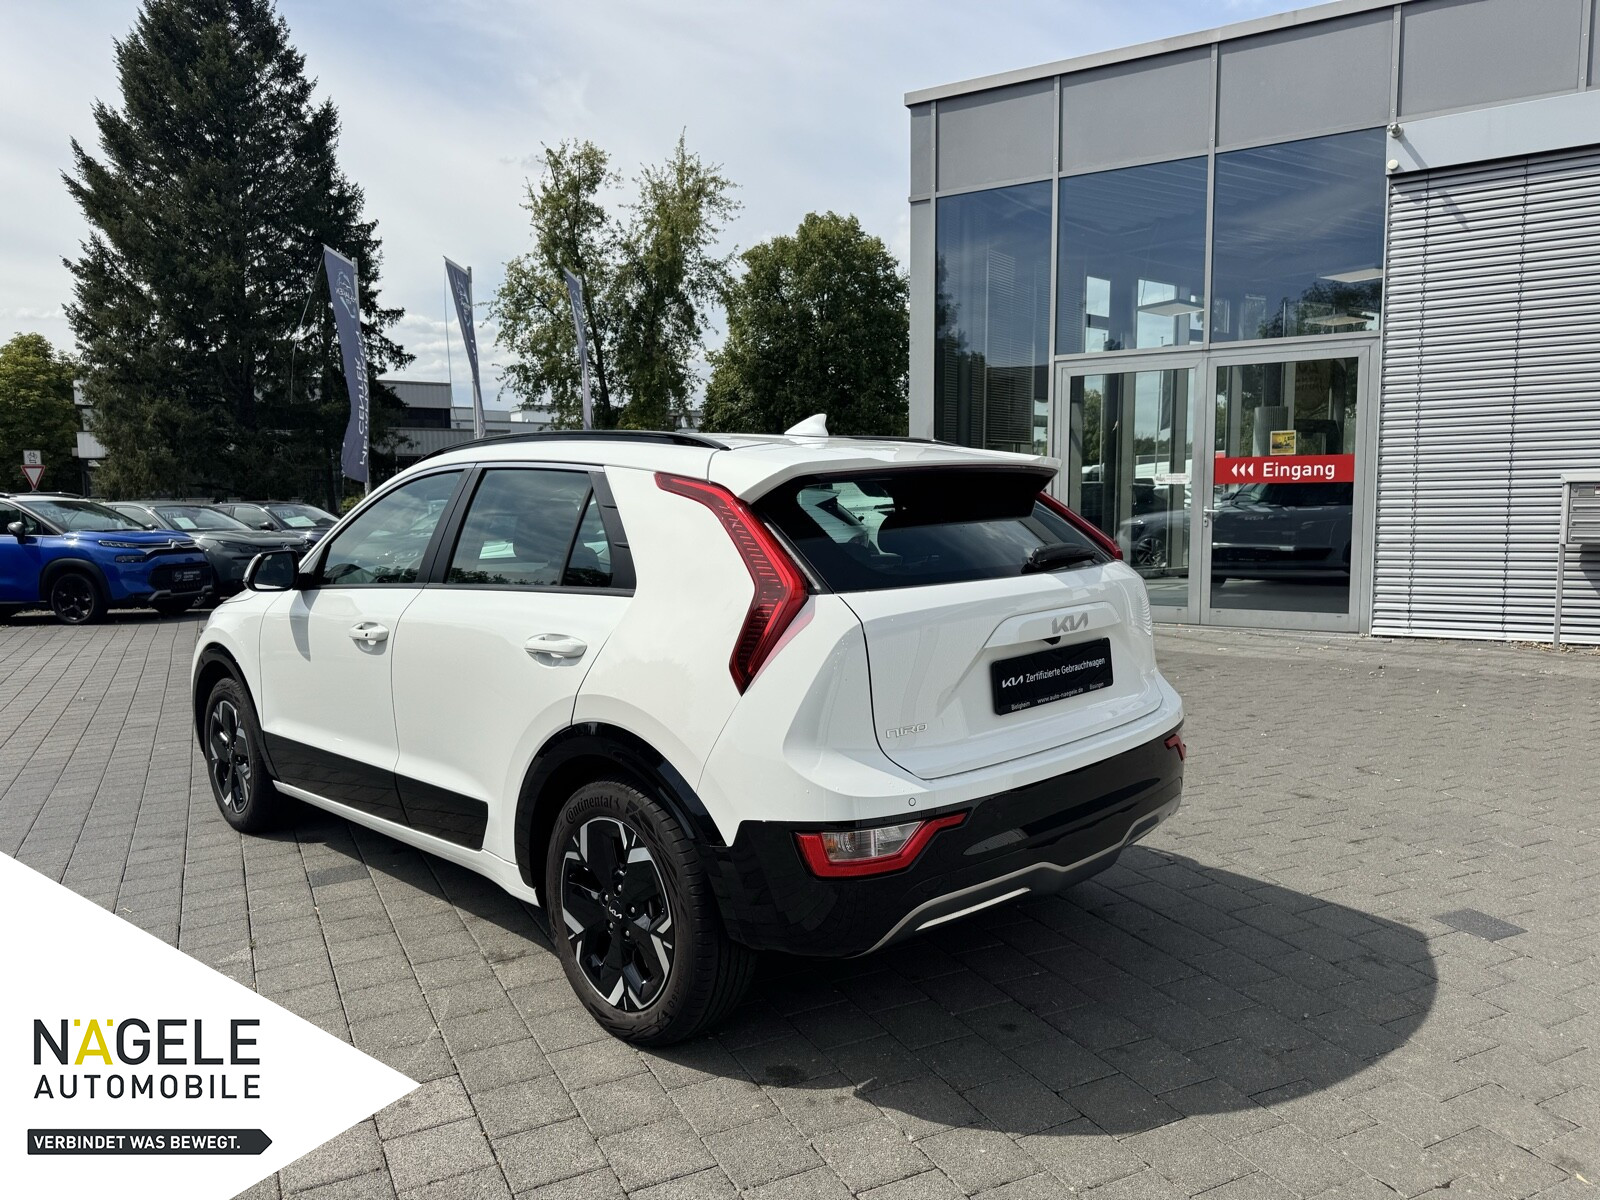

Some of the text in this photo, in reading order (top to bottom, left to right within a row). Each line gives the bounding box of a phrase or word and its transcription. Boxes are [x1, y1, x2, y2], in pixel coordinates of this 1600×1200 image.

[1263, 462, 1335, 480] Eingang
[1026, 667, 1061, 683] Zertifizierte
[1061, 657, 1106, 675] Gebrauchtwagen
[1037, 687, 1084, 704] www.auto-naegele.de
[565, 795, 613, 825] Continental
